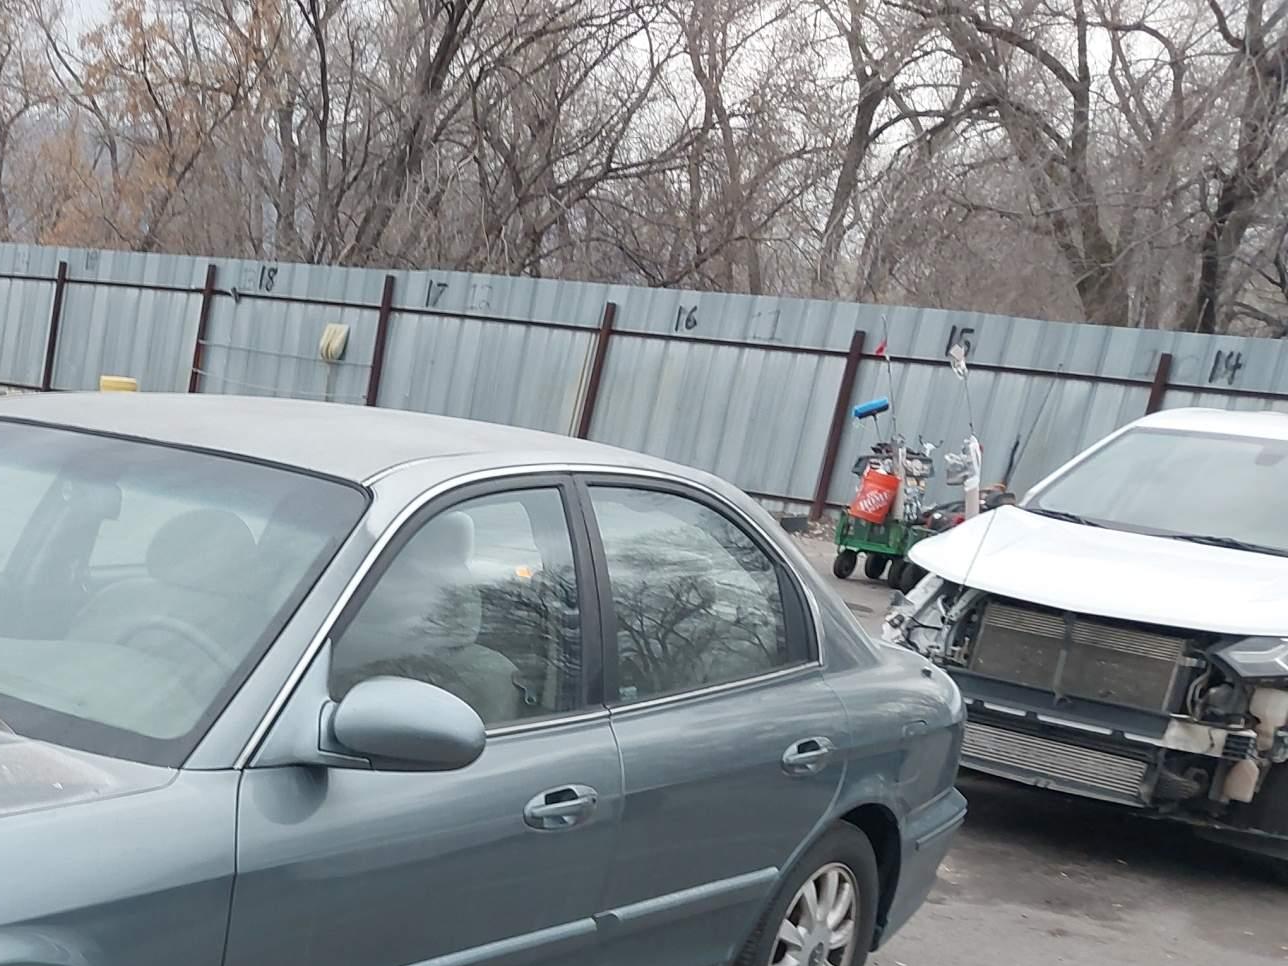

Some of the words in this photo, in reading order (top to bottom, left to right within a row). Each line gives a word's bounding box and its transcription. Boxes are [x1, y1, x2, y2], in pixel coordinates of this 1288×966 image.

[258, 264, 279, 293] 18
[425, 279, 449, 308] 17
[674, 305, 698, 333] 16
[944, 325, 975, 358] 15
[1208, 350, 1243, 386] 14
